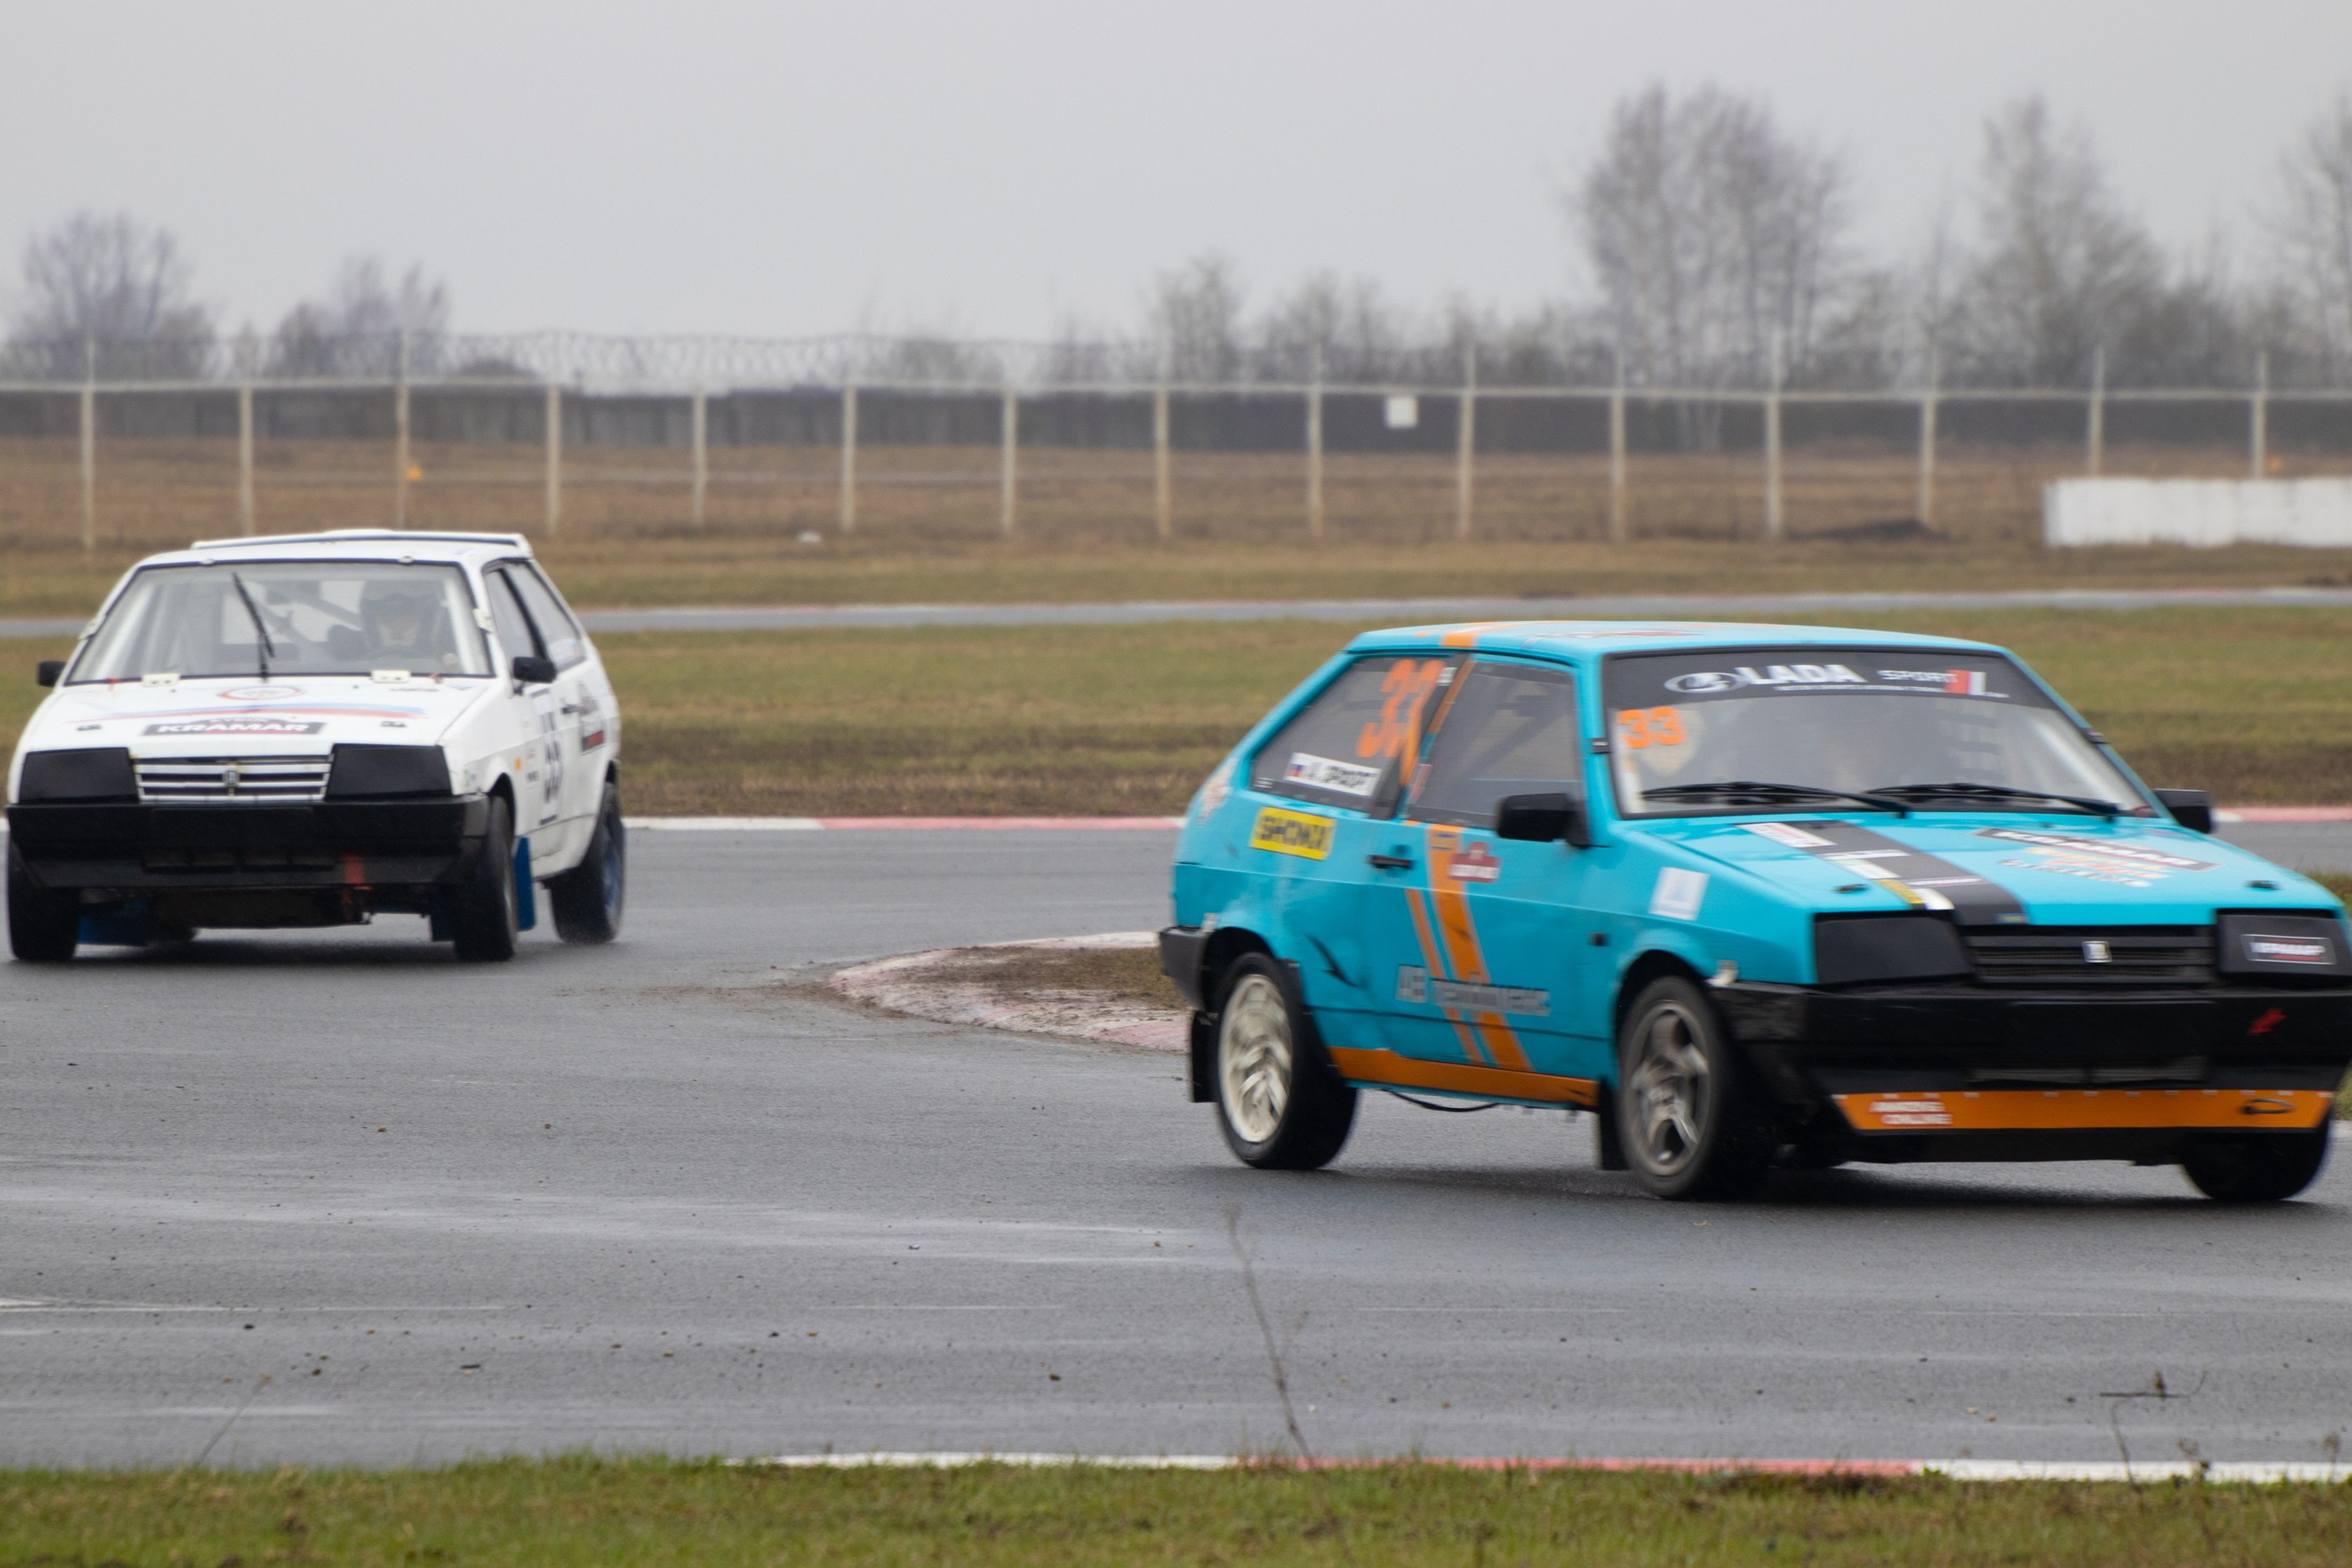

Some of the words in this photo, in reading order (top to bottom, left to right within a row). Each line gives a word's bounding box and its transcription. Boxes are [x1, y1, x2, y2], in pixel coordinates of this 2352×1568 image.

[1734, 664, 1868, 685] LADA
[1876, 670, 1958, 682] SPORT
[157, 723, 311, 732] KRAMAR
[1616, 705, 1685, 749] 33
